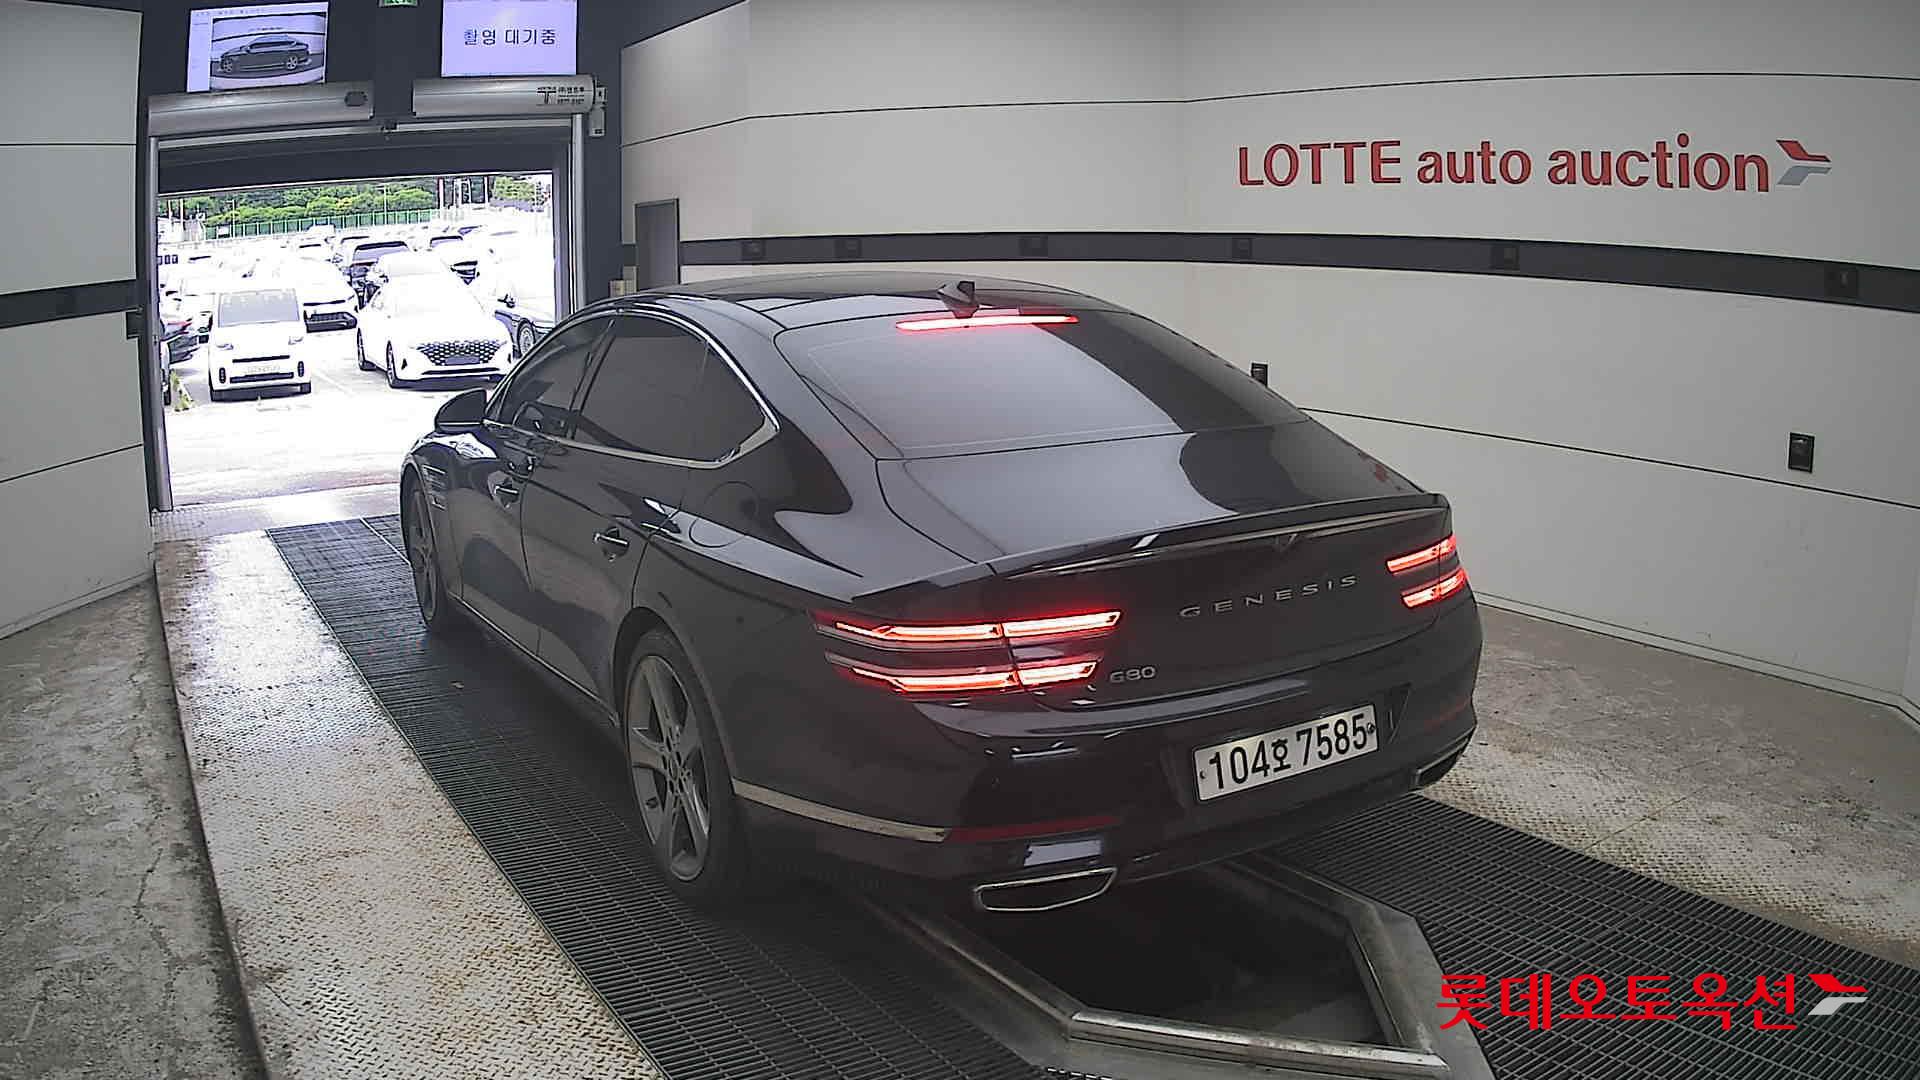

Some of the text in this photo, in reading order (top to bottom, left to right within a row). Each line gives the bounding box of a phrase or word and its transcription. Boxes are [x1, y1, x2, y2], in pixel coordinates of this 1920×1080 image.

[504, 28, 556, 46] 대기중
[1239, 132, 1769, 192] LOTTE auto auction
[1179, 575, 1357, 617] GENESIS
[1110, 665, 1157, 683] G80
